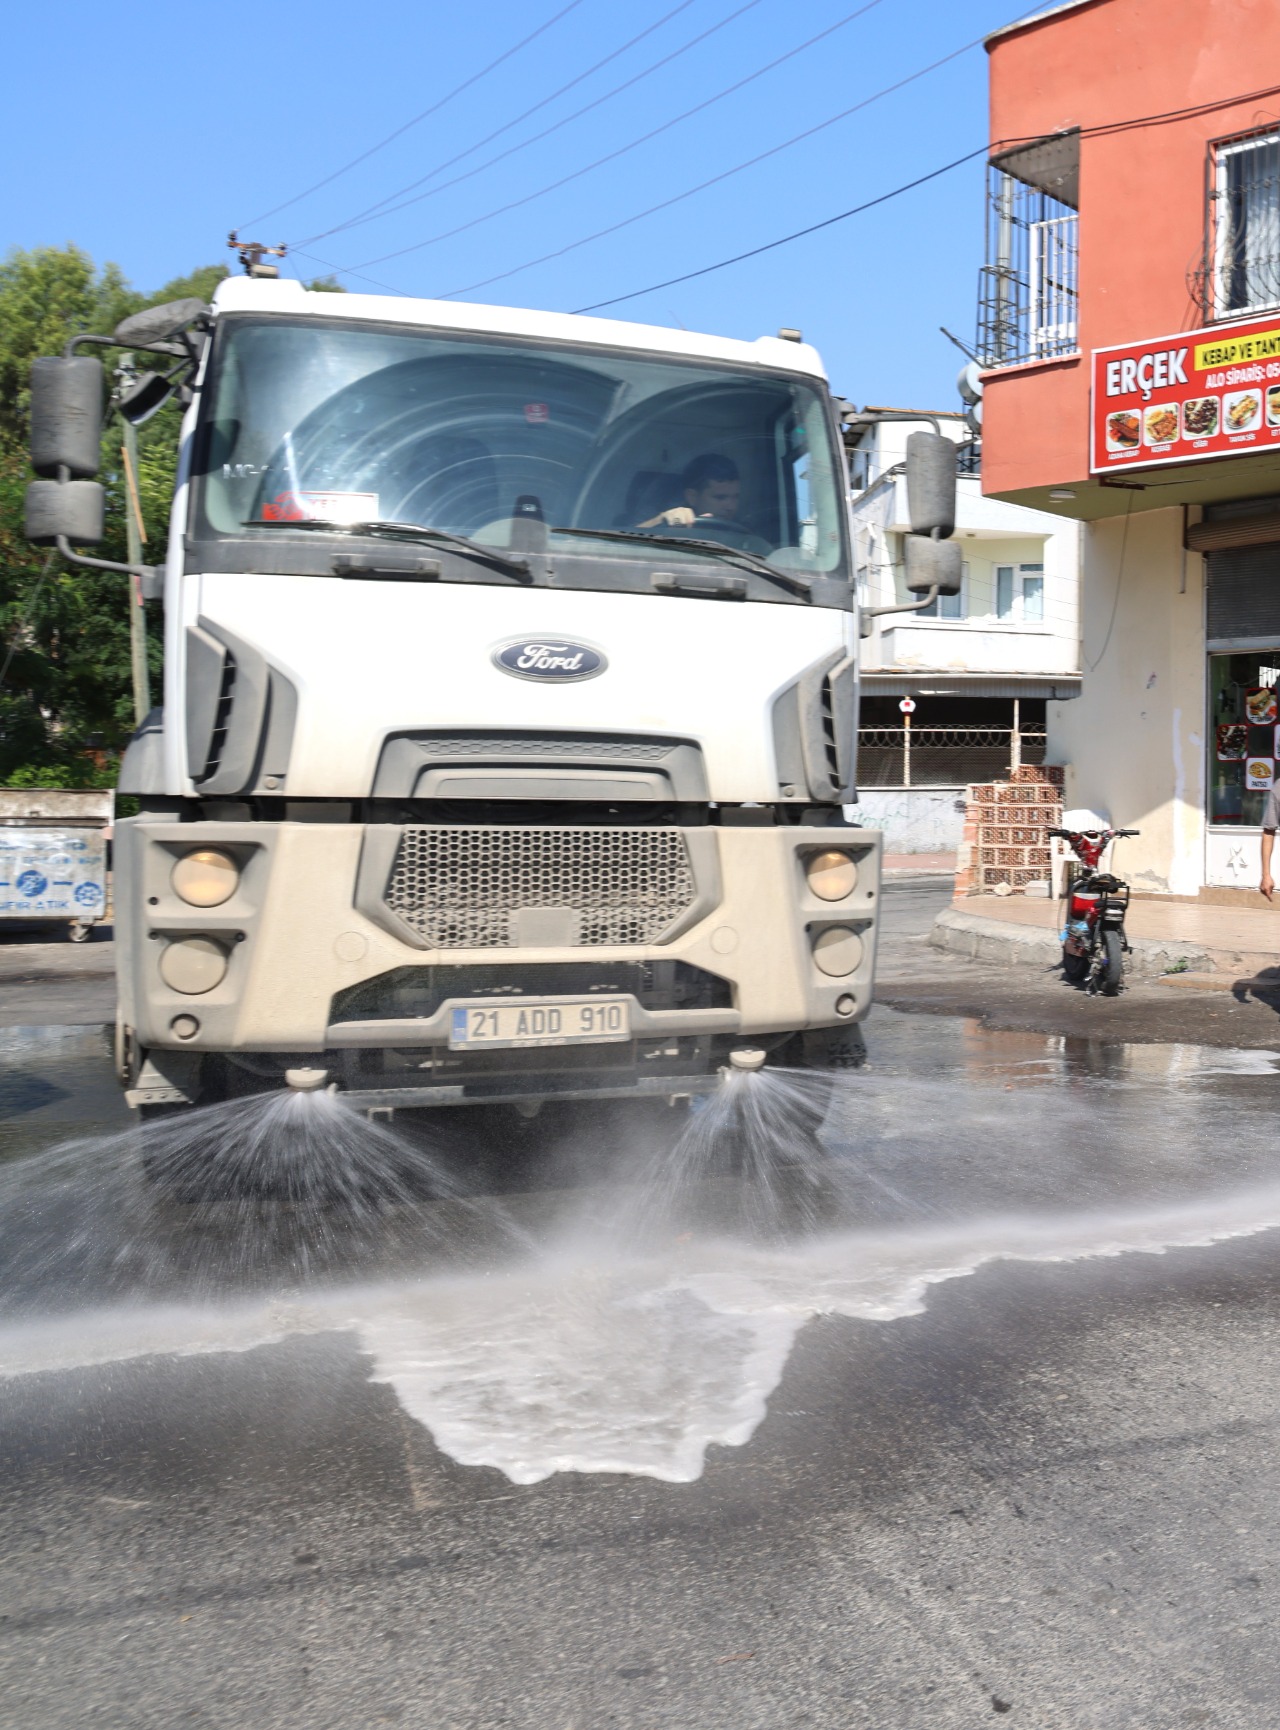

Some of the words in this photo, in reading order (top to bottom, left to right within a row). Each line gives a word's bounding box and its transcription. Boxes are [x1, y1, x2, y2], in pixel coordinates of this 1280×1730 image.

[1202, 345, 1236, 366] KEBAP
[1238, 342, 1253, 359] VE
[1105, 347, 1189, 401] ERÇEK
[1205, 373, 1225, 389] ALO
[1226, 363, 1266, 386] SİPARİŞ:
[517, 644, 584, 670] Ford
[471, 1010, 499, 1038] 21
[516, 1008, 562, 1036] ADD
[580, 1005, 622, 1032] 910
